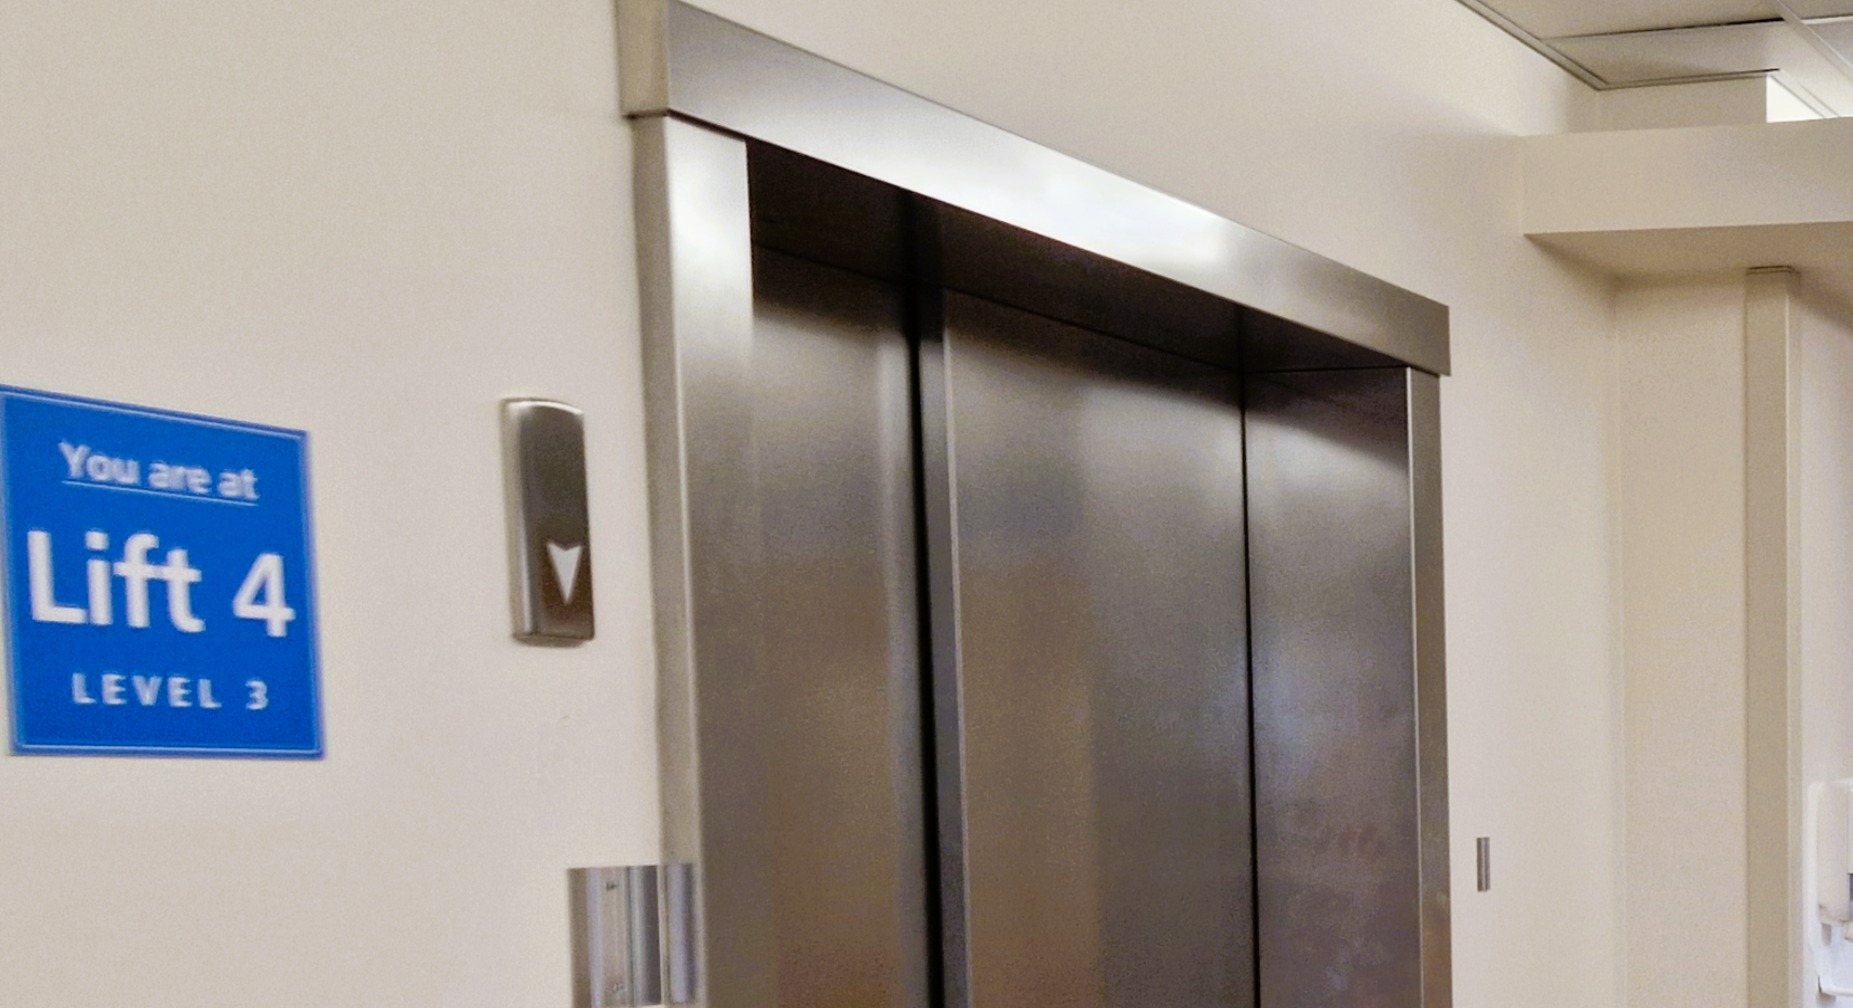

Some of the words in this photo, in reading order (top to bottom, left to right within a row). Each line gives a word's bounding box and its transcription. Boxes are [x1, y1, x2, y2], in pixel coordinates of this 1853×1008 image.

[59, 440, 140, 484] You
[148, 459, 210, 494] are
[218, 468, 259, 500] at
[27, 529, 206, 633] Lift
[232, 553, 296, 638] 4
[71, 672, 222, 709] LEVEL
[245, 679, 269, 711] 3
